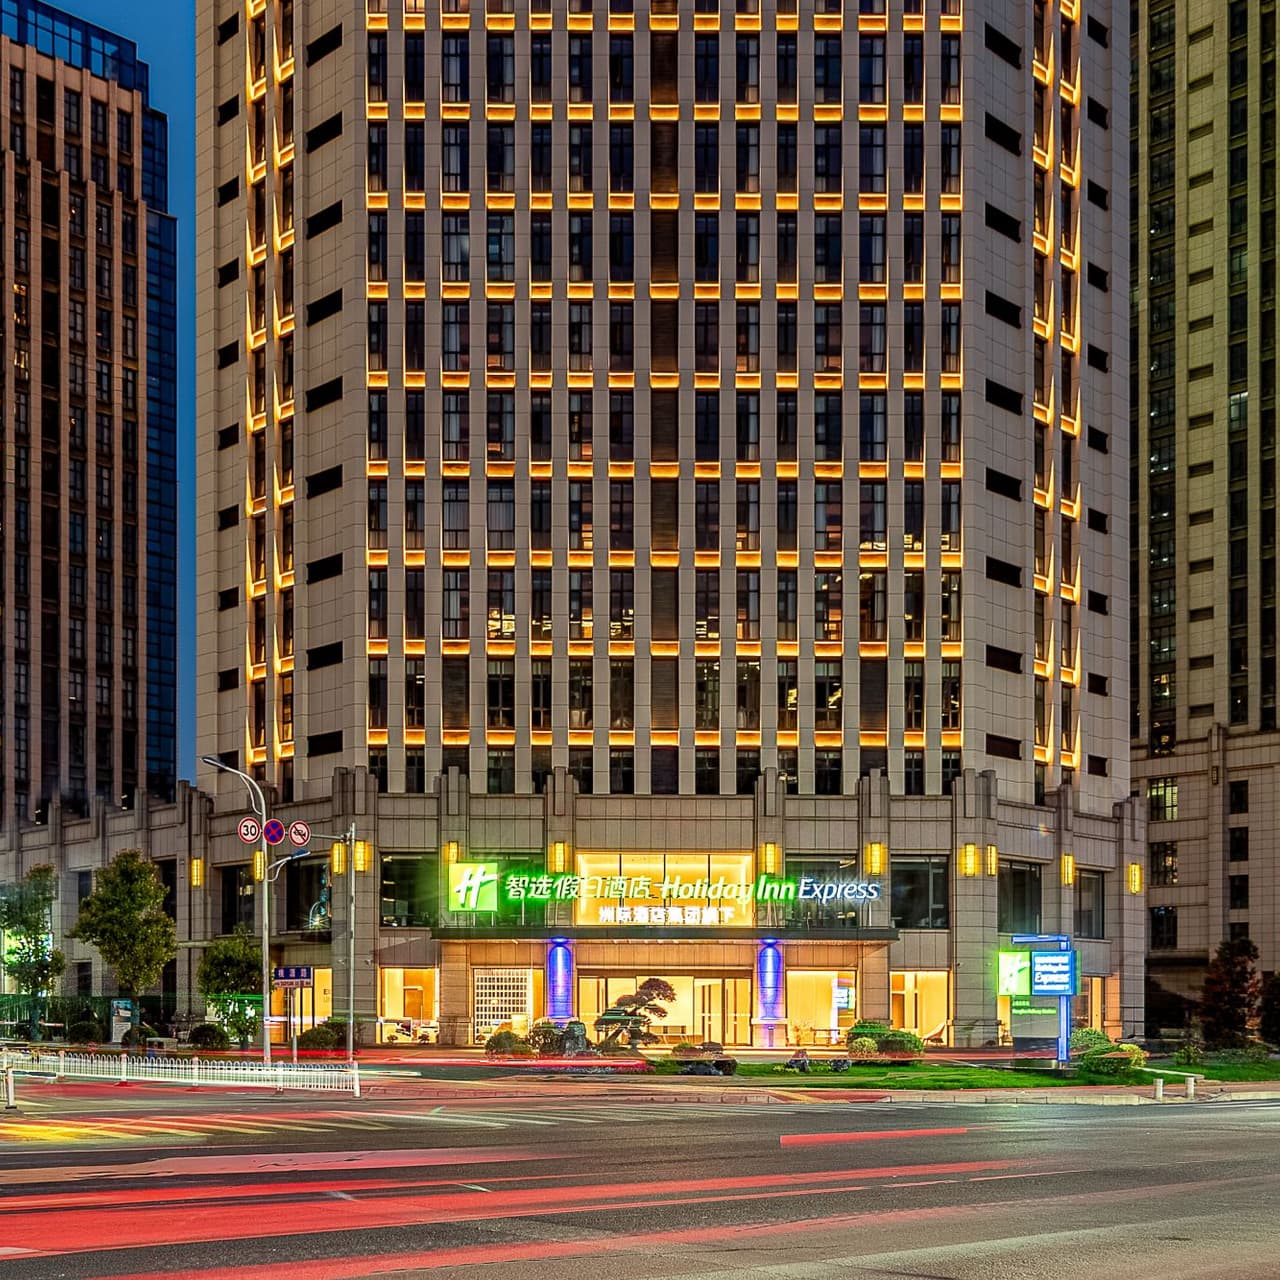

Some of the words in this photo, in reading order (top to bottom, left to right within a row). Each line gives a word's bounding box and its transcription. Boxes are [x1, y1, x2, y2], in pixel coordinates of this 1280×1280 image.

[242, 824, 257, 836] 30
[505, 874, 652, 900] 智选假日酒店
[656, 874, 754, 904] Holiday
[757, 874, 795, 900] Inn
[798, 878, 880, 904] Express
